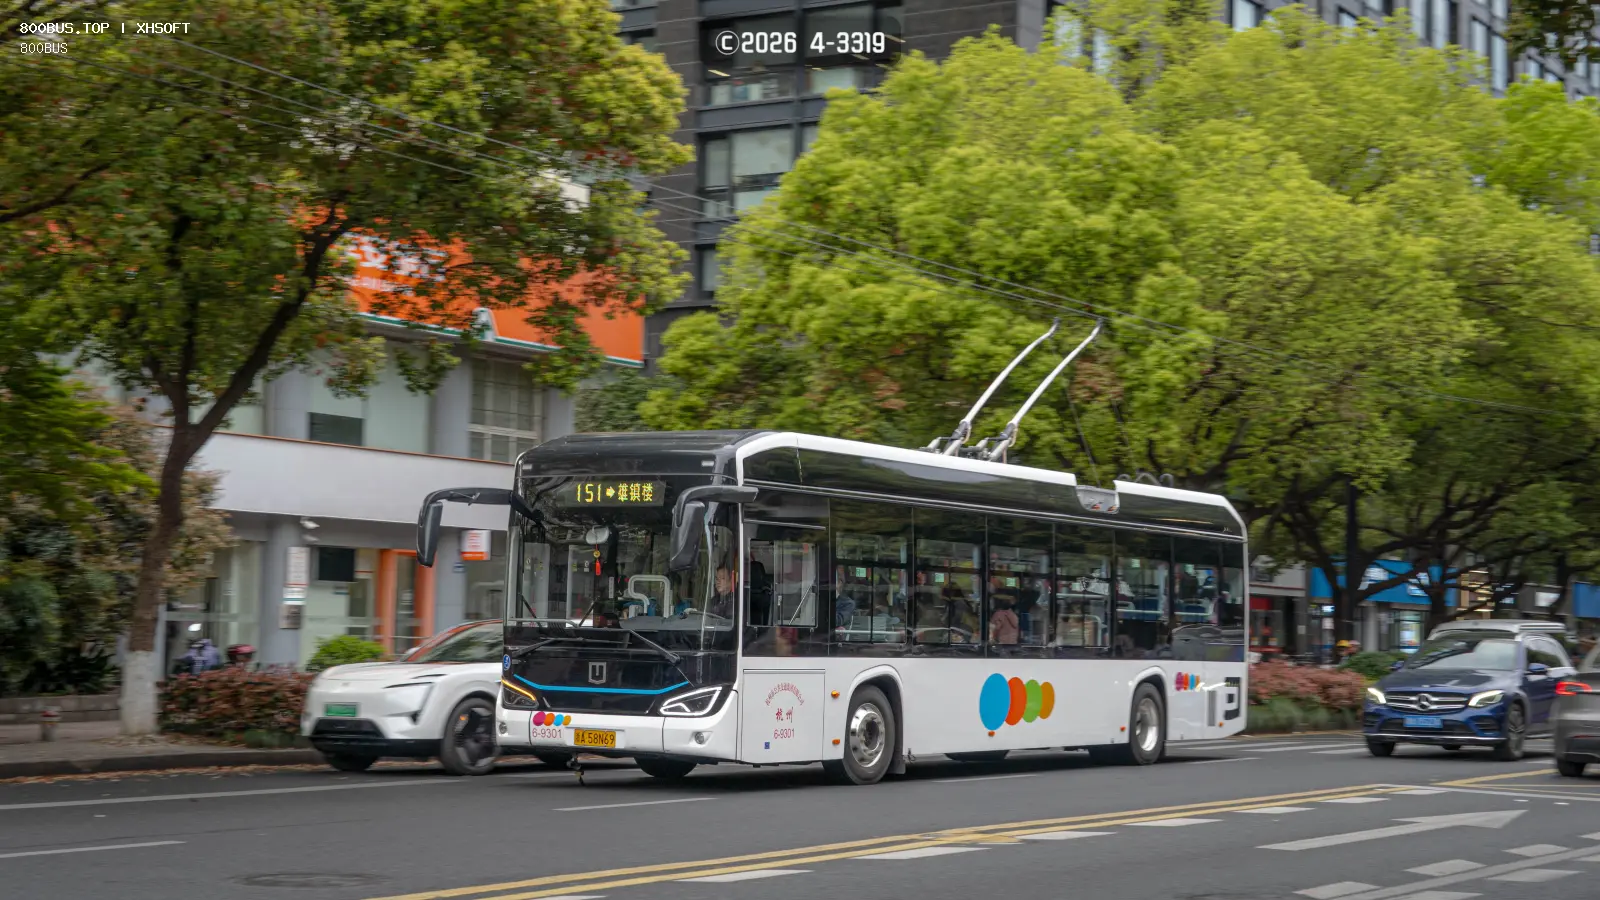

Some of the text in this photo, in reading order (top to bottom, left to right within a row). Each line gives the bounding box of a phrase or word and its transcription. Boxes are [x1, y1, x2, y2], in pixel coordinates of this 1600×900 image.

[577, 484, 601, 502] 151
[532, 728, 562, 739] 6-9301
[774, 728, 794, 739] 6-9301
